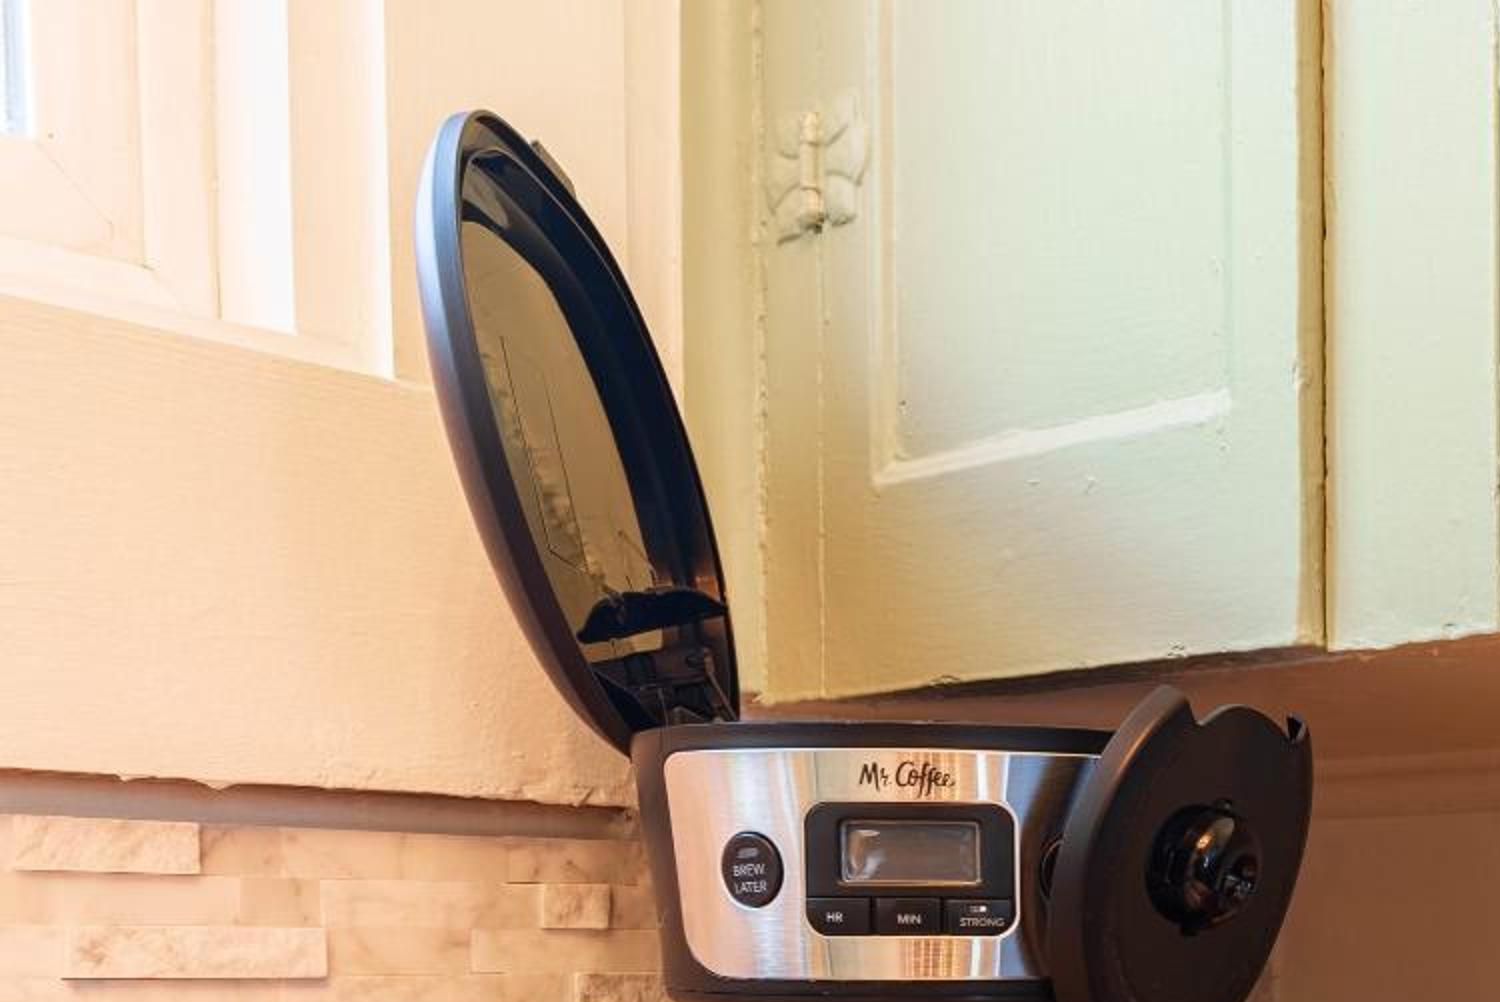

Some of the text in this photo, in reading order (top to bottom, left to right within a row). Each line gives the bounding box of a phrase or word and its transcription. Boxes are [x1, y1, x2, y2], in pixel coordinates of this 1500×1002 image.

[859, 761, 956, 798] Mr. Coffee
[733, 863, 766, 877] BREW
[734, 880, 767, 894] LATER
[826, 912, 843, 923] HR
[897, 914, 922, 925] MIN
[960, 917, 1005, 927] STRONG
